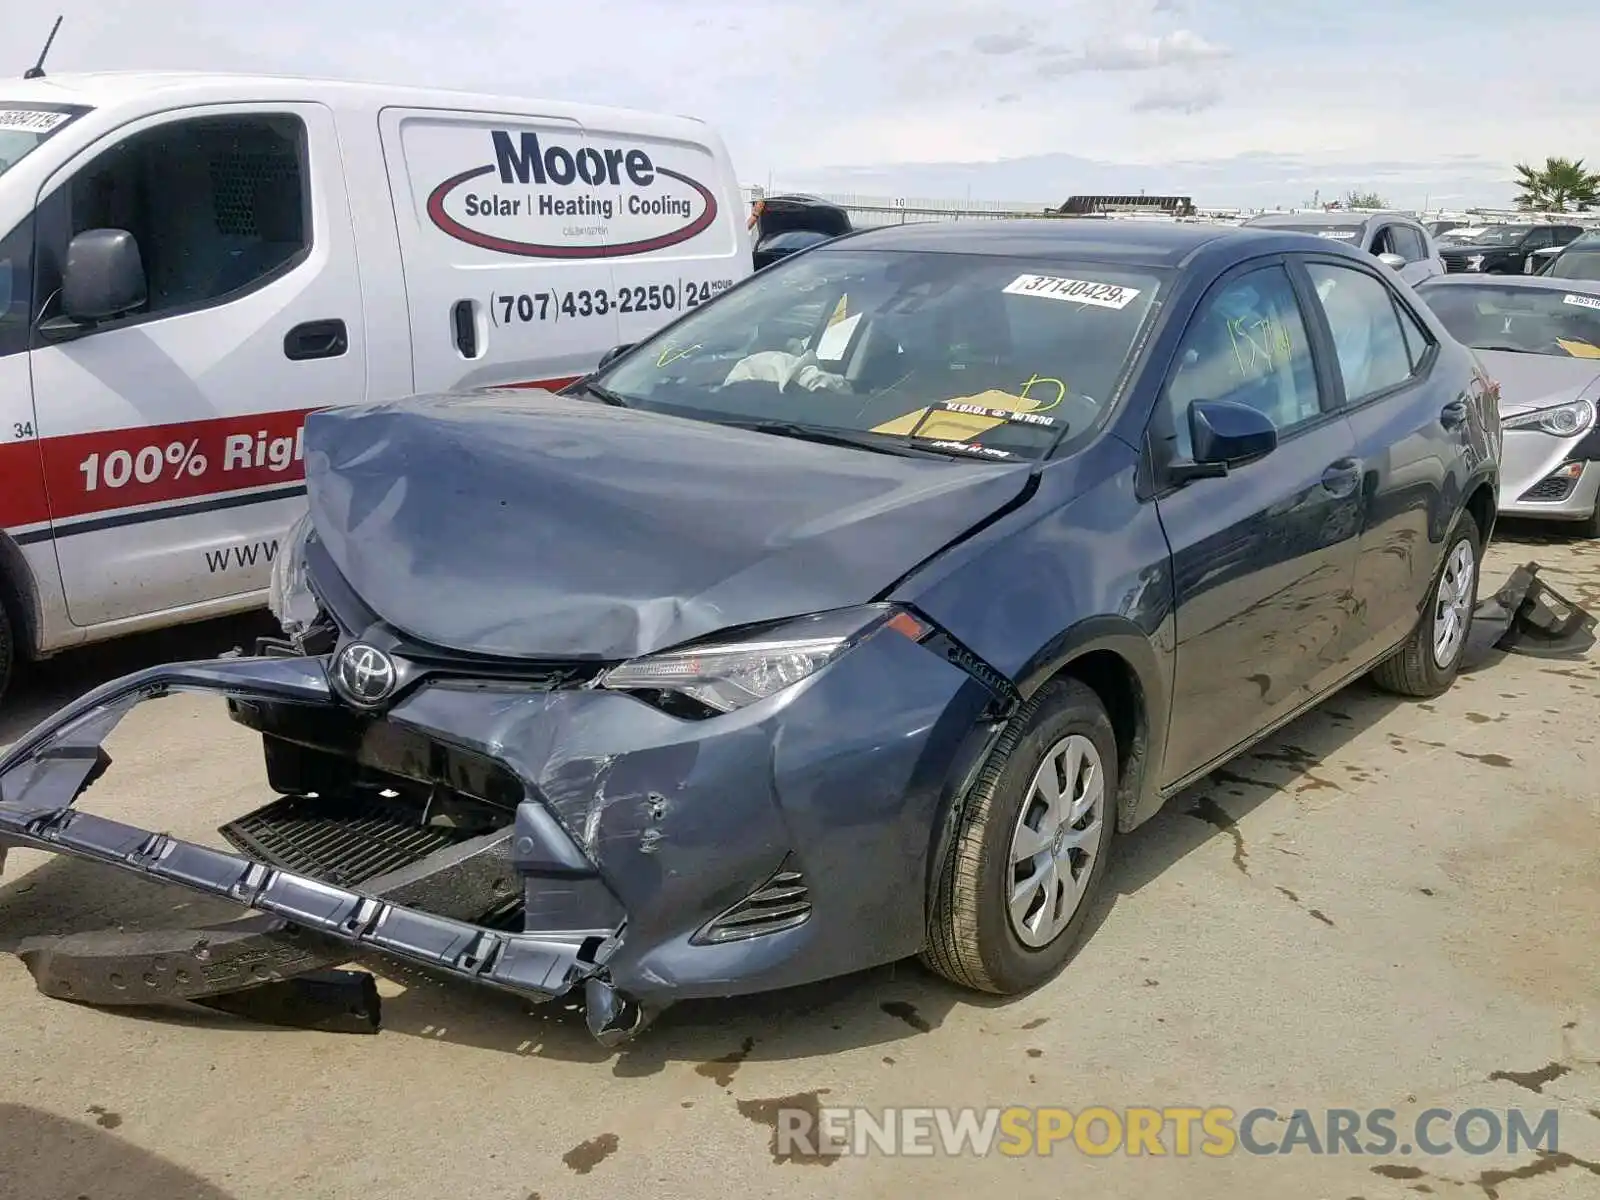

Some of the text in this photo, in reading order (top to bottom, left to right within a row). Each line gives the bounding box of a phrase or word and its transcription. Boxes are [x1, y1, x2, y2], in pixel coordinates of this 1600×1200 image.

[491, 130, 655, 187] Moore
[465, 194, 692, 219] Solar Heating Cooling
[686, 281, 711, 307] 24
[945, 402, 1054, 426] DUBLIN TOYOTA
[14, 421, 34, 439] 34
[79, 438, 208, 492] 100%
